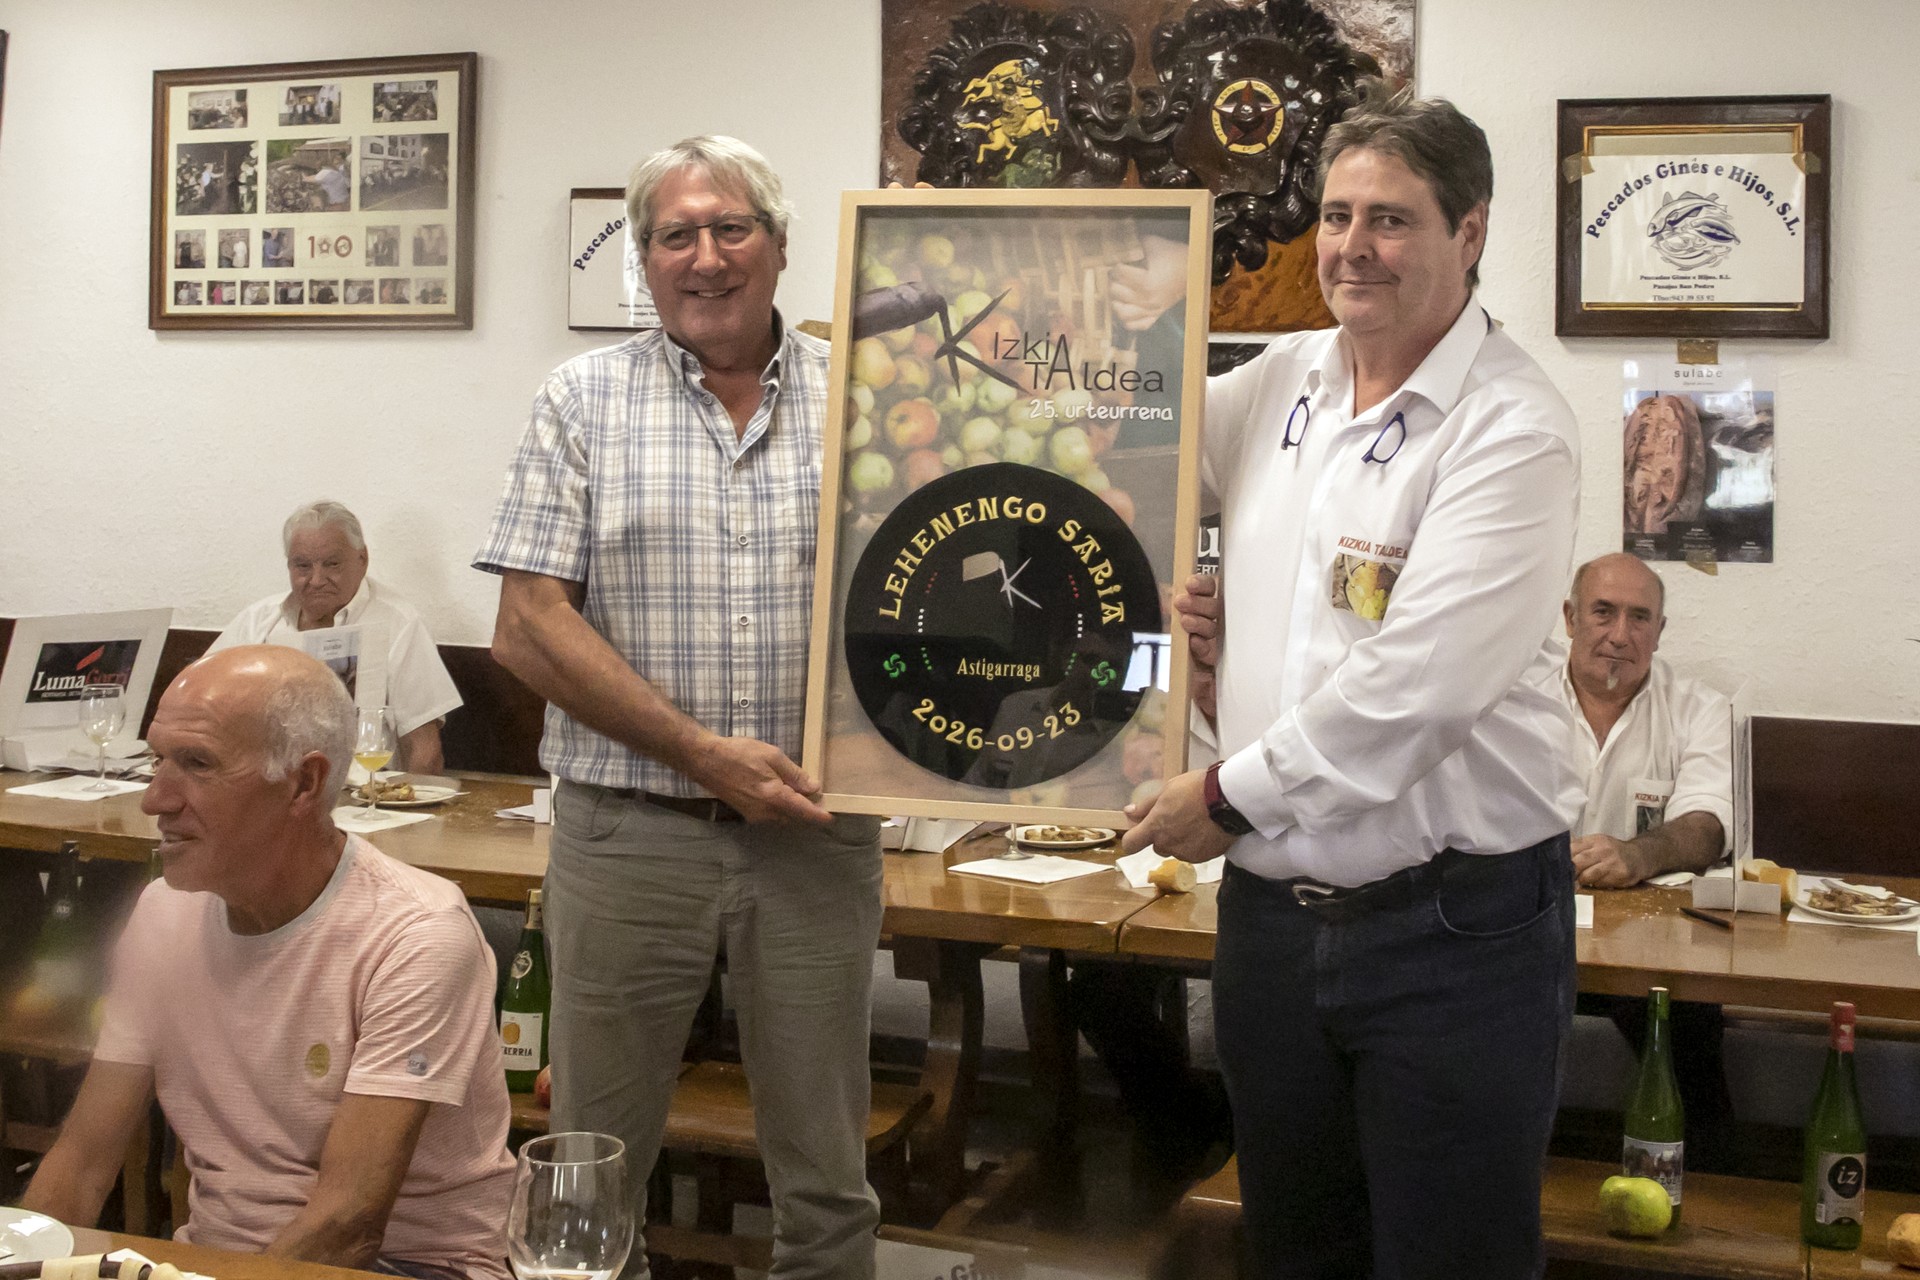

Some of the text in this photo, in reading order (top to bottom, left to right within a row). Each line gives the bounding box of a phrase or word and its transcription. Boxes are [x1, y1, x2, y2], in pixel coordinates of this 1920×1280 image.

[1586, 157, 1801, 238] Pescados Ginés e Hijos, S.L.
[1674, 368, 1723, 378] sulabe
[1029, 399, 1173, 420] 25. urteurrena
[1338, 535, 1371, 553] KIZKIA
[879, 496, 1046, 620] LEHENENGO
[957, 657, 1040, 682] Astigarraga
[912, 698, 1081, 751] 2026-09-23
[1837, 1166, 1858, 1184] iz
